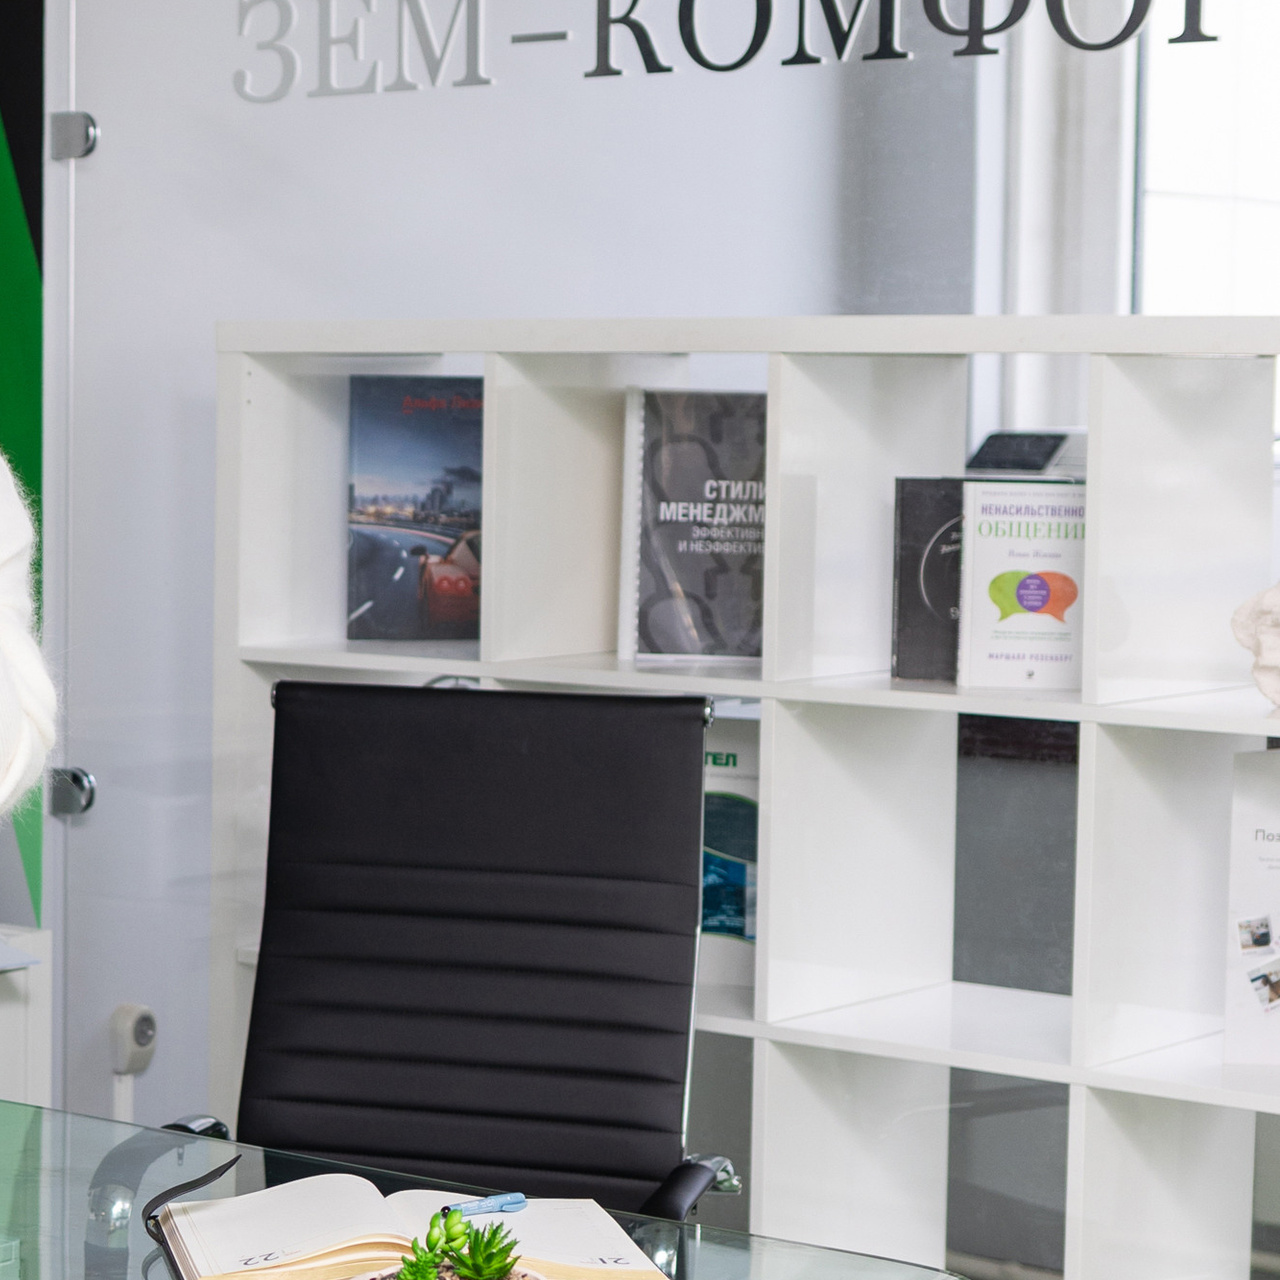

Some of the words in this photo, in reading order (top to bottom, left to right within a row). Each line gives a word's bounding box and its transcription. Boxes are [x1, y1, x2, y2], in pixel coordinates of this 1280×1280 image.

[660, 502, 766, 525] МЕНЕДЖМ
[678, 540, 688, 553] И
[238, 1251, 280, 1266] 22
